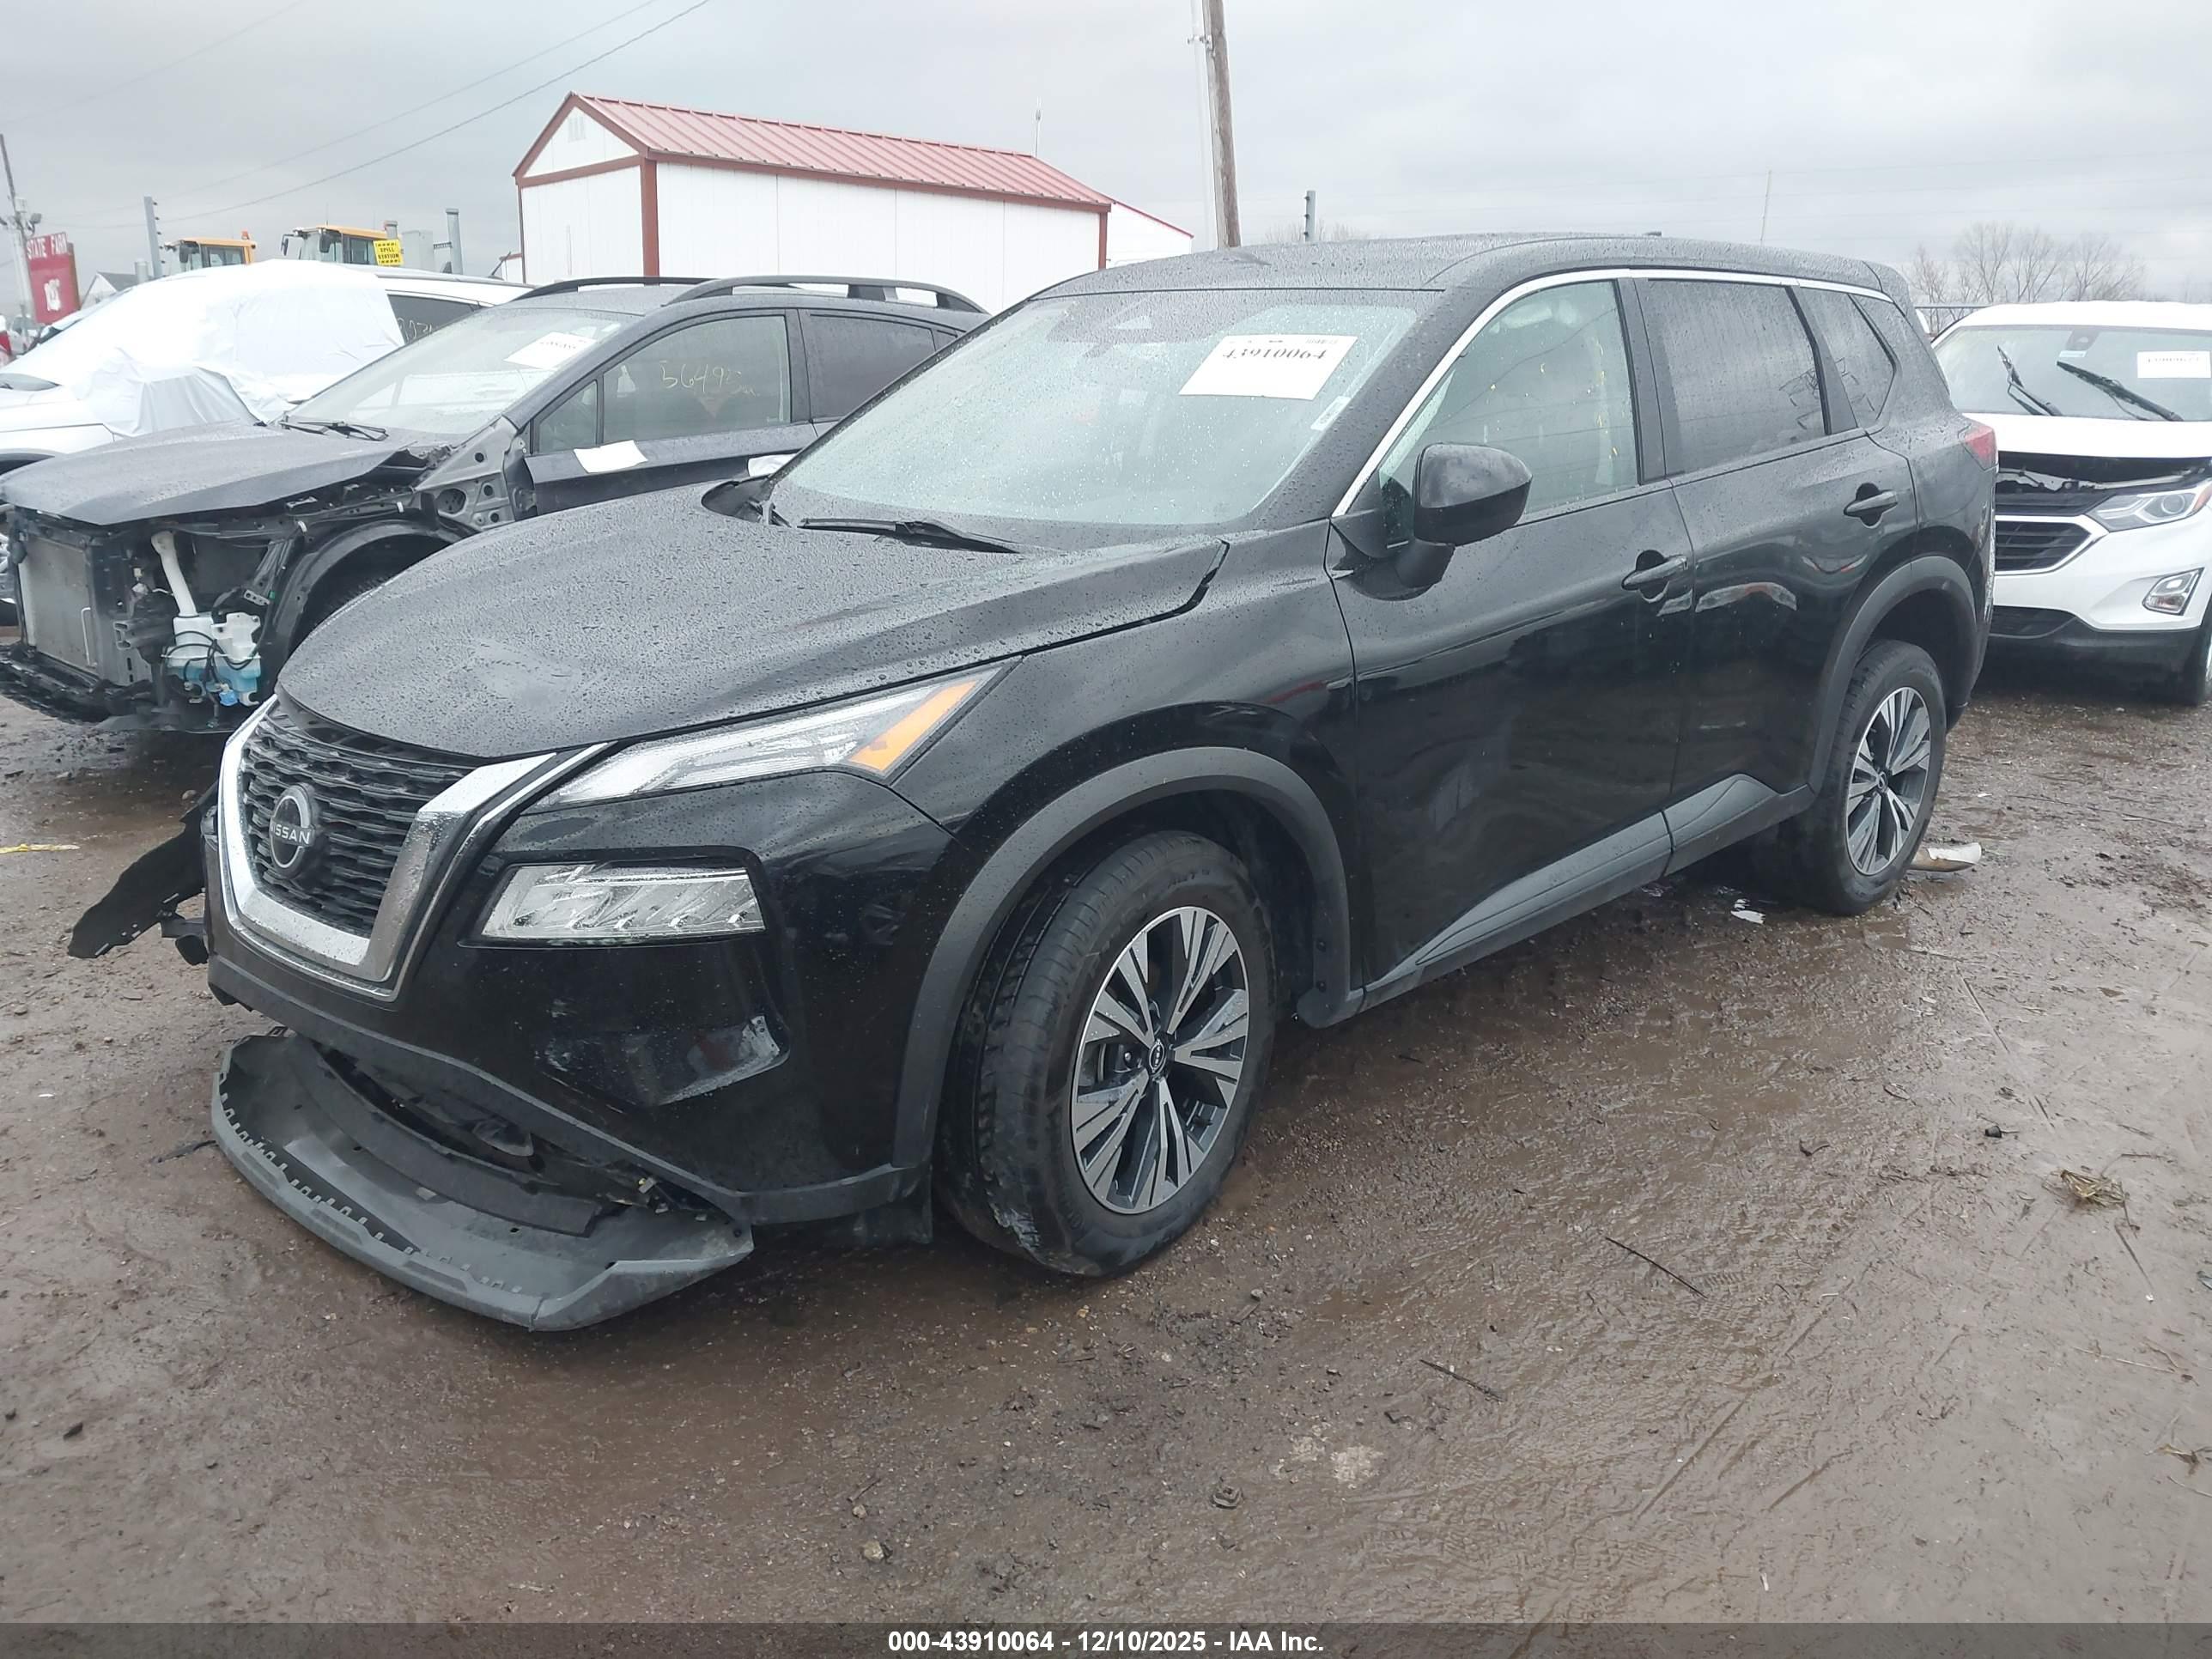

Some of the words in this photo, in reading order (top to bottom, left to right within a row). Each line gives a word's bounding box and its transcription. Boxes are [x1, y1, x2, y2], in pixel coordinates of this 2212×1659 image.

[27, 237, 47, 260] STATE
[50, 232, 68, 256] FARM
[270, 822, 311, 845] NISSAN
